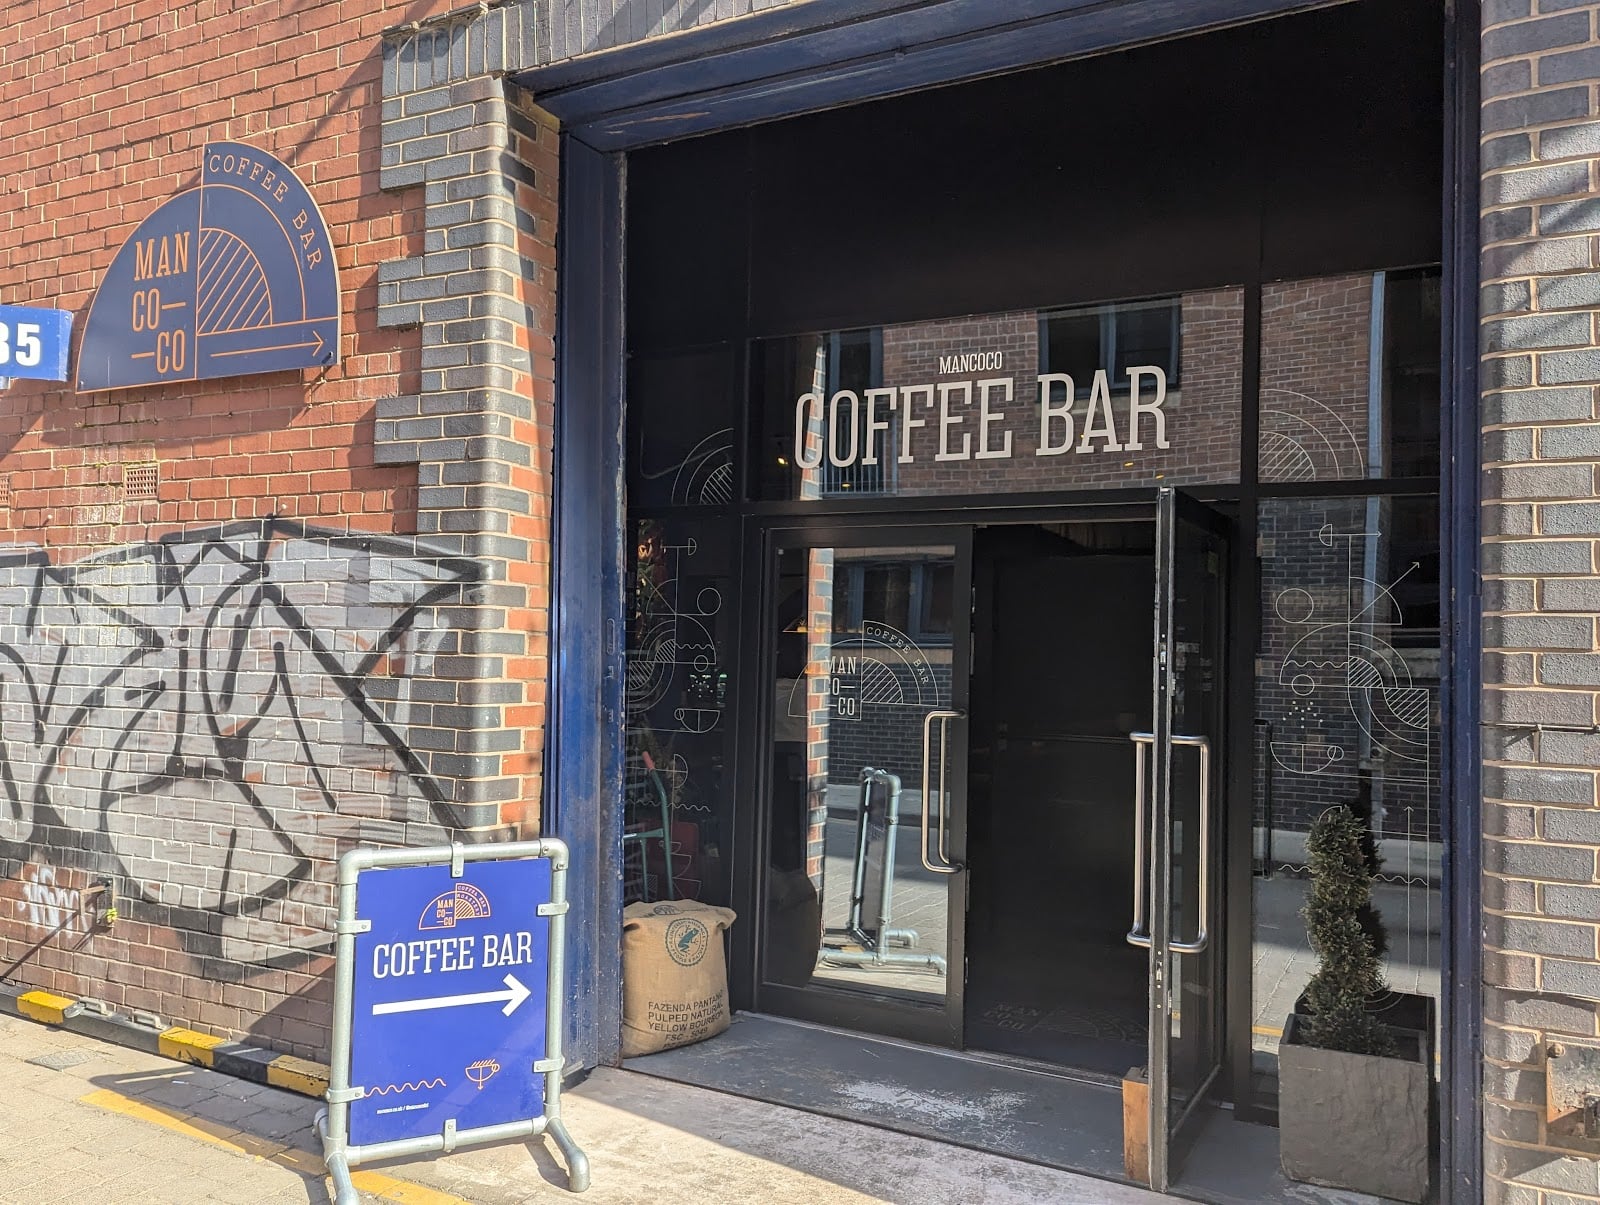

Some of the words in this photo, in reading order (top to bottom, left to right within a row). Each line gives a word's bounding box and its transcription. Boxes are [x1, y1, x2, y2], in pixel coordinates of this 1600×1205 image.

[208, 153, 290, 204] COFFEE
[291, 208, 323, 271] BAR
[133, 231, 191, 282] MAN
[938, 351, 1003, 375] MANCOCO
[794, 376, 1014, 470] COFFEE
[1035, 365, 1171, 458] BAR
[825, 655, 858, 675] MAN
[865, 626, 911, 655] COFFEE
[913, 658, 930, 685] BAR
[372, 935, 476, 980] COFFEE
[482, 930, 533, 969] BAR
[648, 1001, 692, 1013] FAZENDA
[648, 1011, 689, 1023] PULPED
[690, 1001, 724, 1021] NATURAL
[648, 1021, 688, 1033] YELLOW
[664, 1033, 684, 1042] FSC
